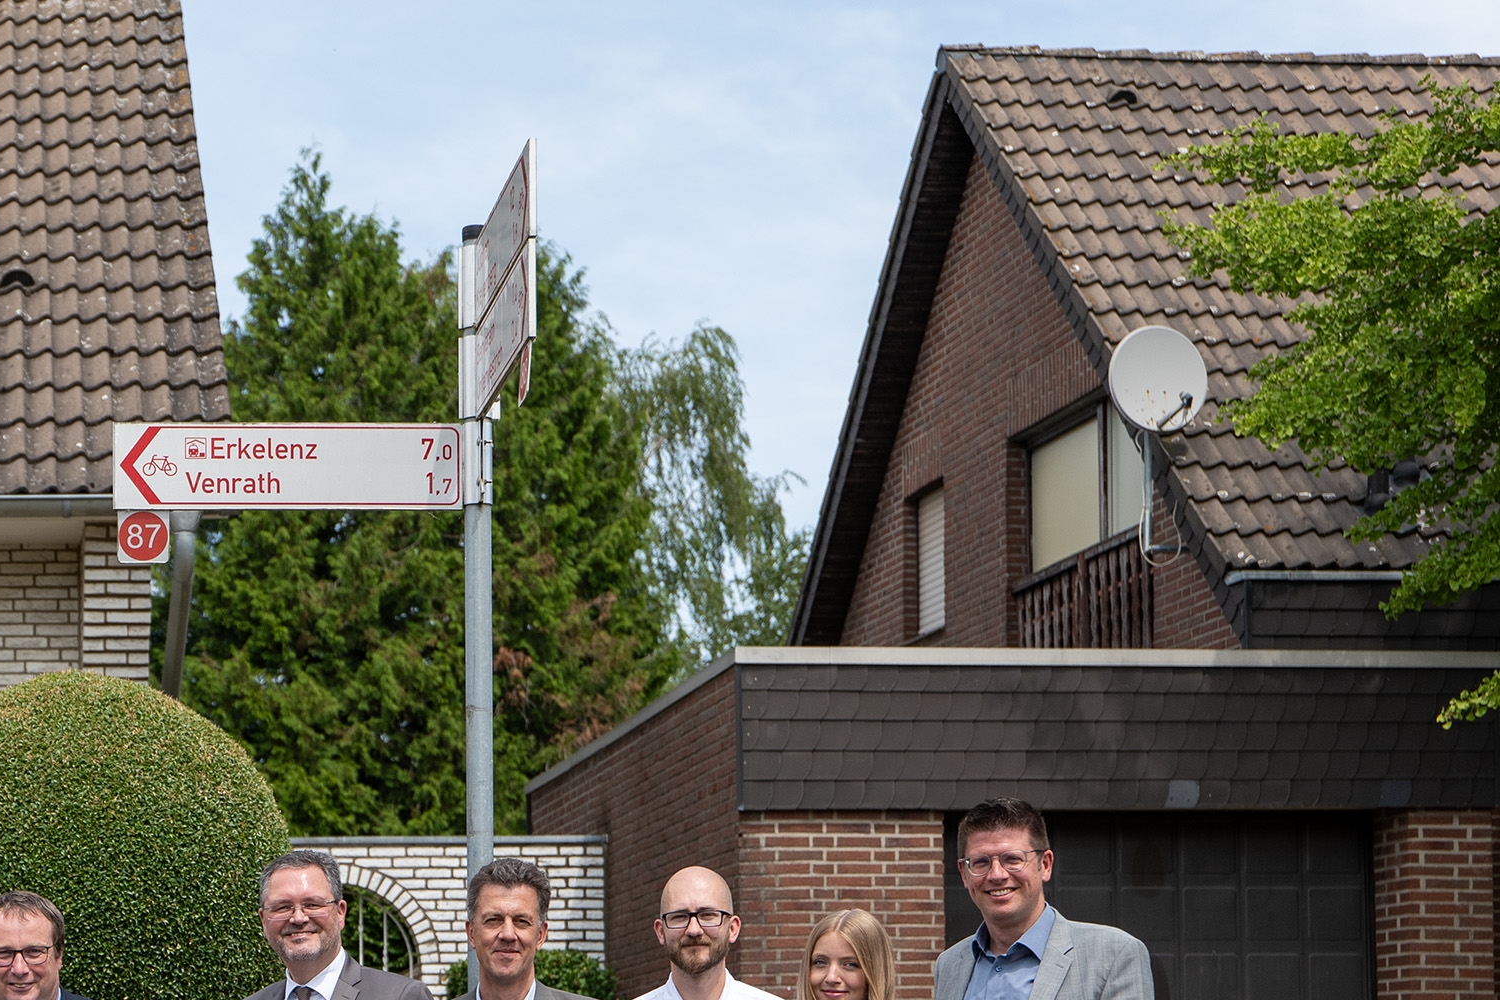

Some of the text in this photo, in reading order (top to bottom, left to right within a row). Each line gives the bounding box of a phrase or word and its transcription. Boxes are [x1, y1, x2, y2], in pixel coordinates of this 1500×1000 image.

[211, 437, 453, 461] Erkelenz 7,0
[186, 471, 453, 495] Venrath 1,7
[126, 523, 162, 550] 87
